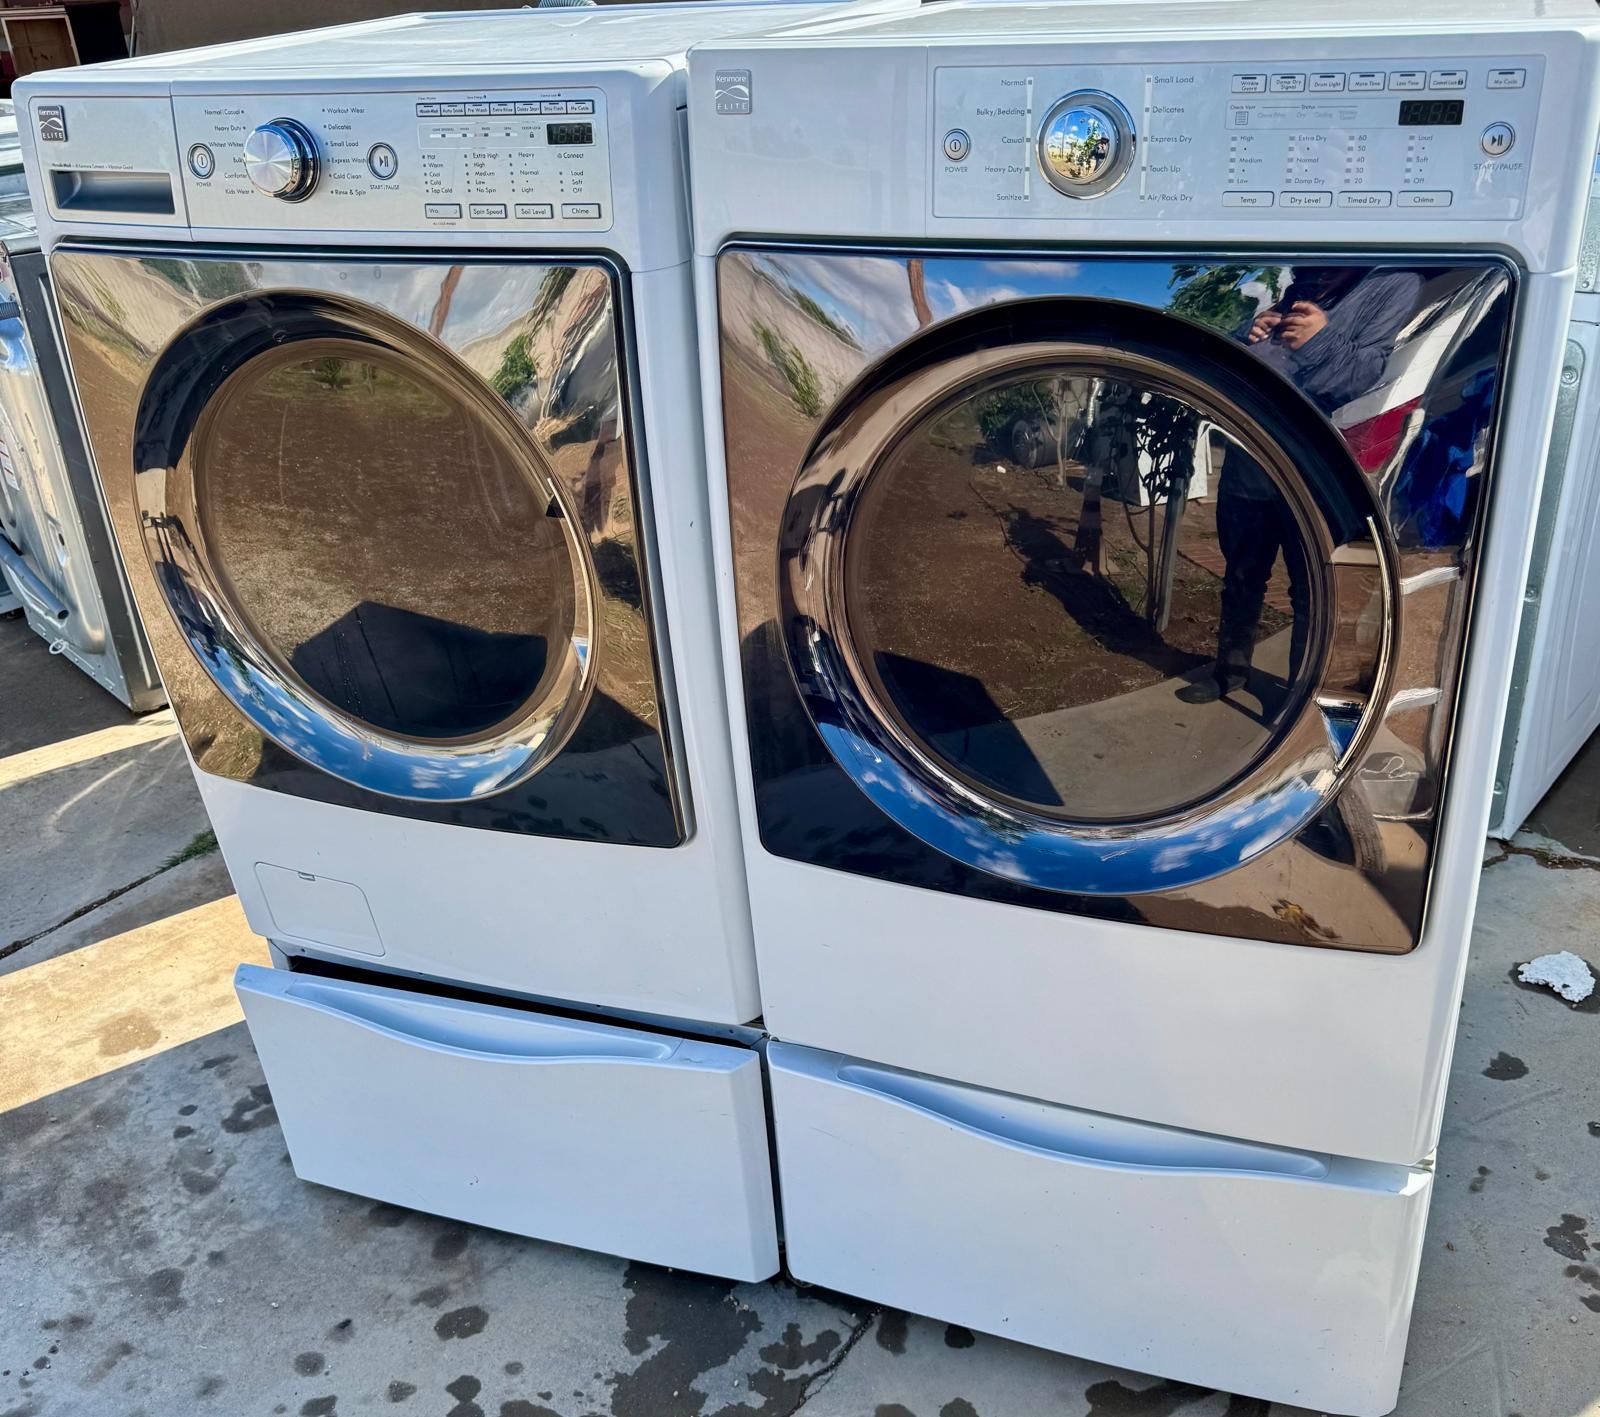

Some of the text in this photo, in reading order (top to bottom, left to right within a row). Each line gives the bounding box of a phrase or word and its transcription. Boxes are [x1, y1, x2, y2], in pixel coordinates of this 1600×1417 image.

[716, 74, 747, 83] Kenmore
[1153, 76, 1194, 84] Small Load
[717, 102, 747, 110] ELITE
[1152, 106, 1185, 114] Delicates
[976, 108, 1025, 117] Bulky/Bedding
[230, 124, 242, 132] Duty
[1150, 135, 1193, 144] Express Dry
[1315, 135, 1327, 143] Dry
[486, 152, 499, 160] High
[562, 151, 584, 159] Connect
[331, 157, 351, 165] Express
[984, 165, 1023, 174] Heavy Duty
[1149, 165, 1181, 174] Touch Up
[1473, 163, 1524, 171] START/PAUSE
[354, 189, 367, 197] Spin
[1147, 194, 1193, 202] Air/Rack Dry
[1240, 196, 1257, 205] Temp
[1290, 196, 1321, 205] Dry Level
[1347, 196, 1381, 205] Timed Dry
[1413, 196, 1435, 204] Chime
[571, 207, 590, 215] Chime
